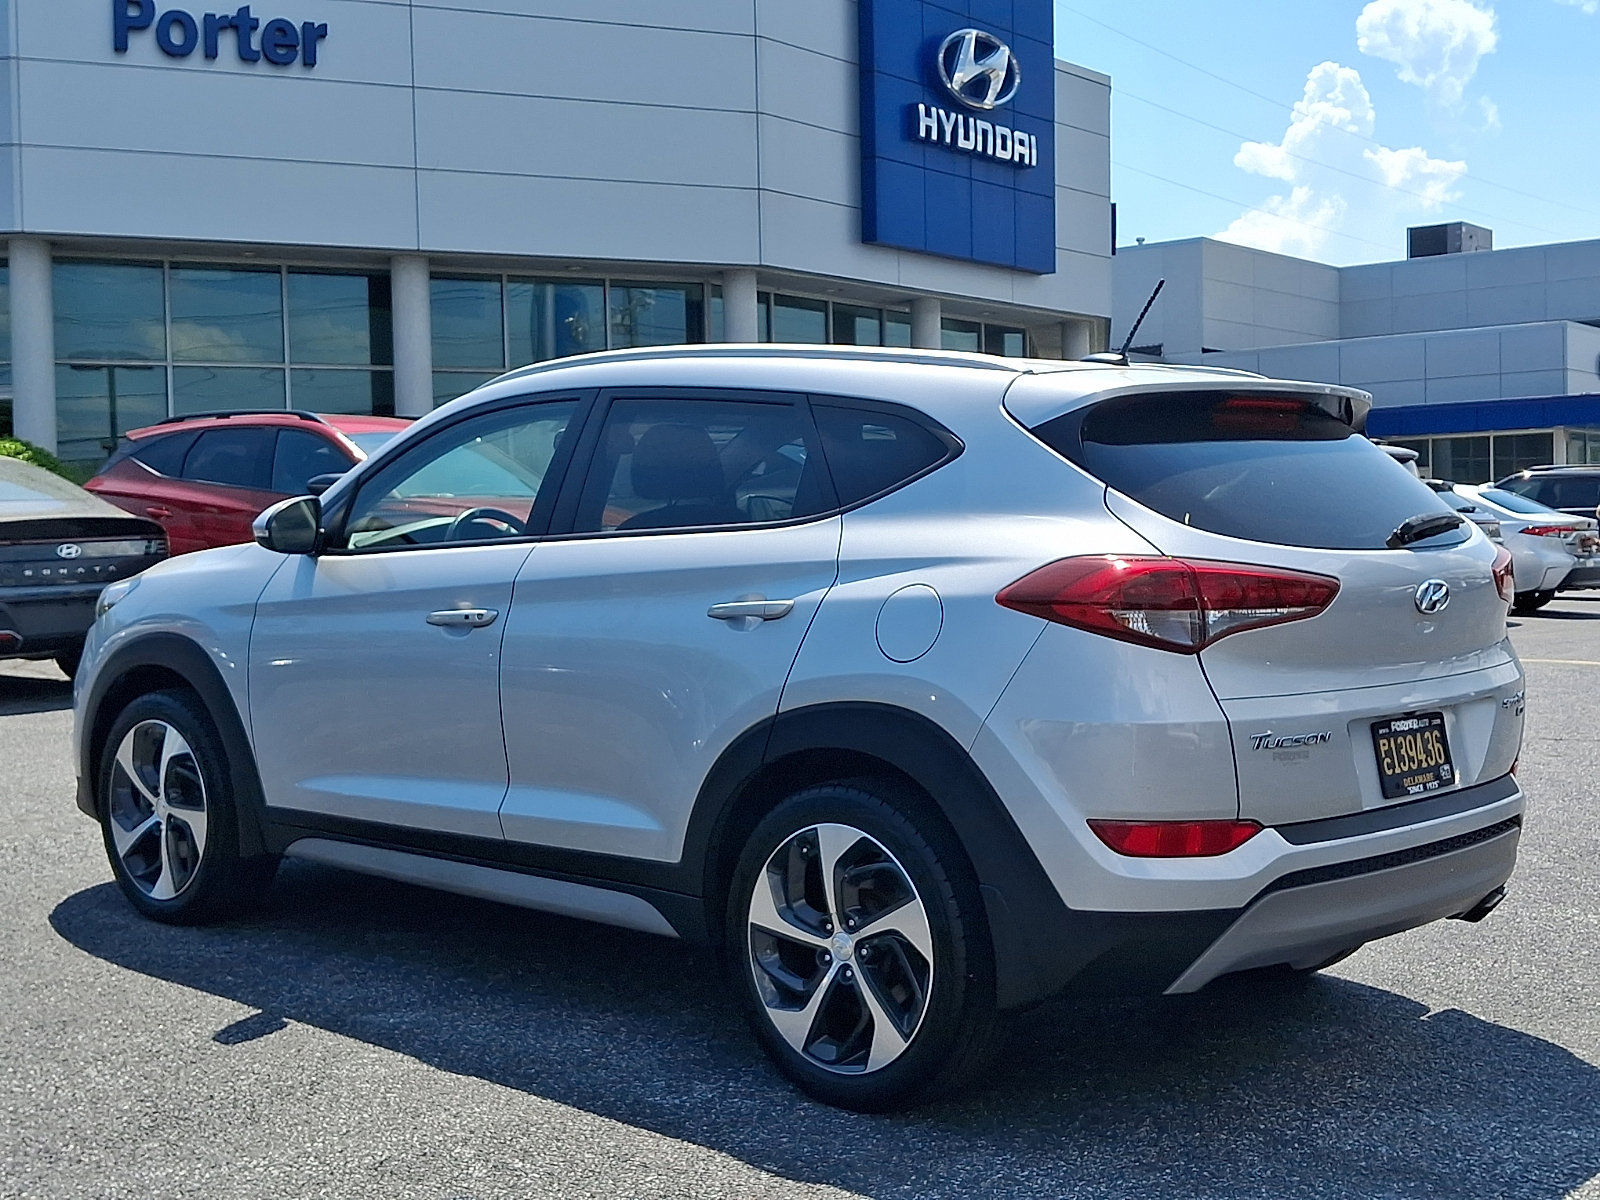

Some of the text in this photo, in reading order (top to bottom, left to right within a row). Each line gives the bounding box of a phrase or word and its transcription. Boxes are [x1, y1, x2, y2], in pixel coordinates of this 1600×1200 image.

[113, 0, 328, 67] Porter
[918, 103, 1037, 167] HYUNDAI
[1403, 772, 1435, 787] DELAWARE
